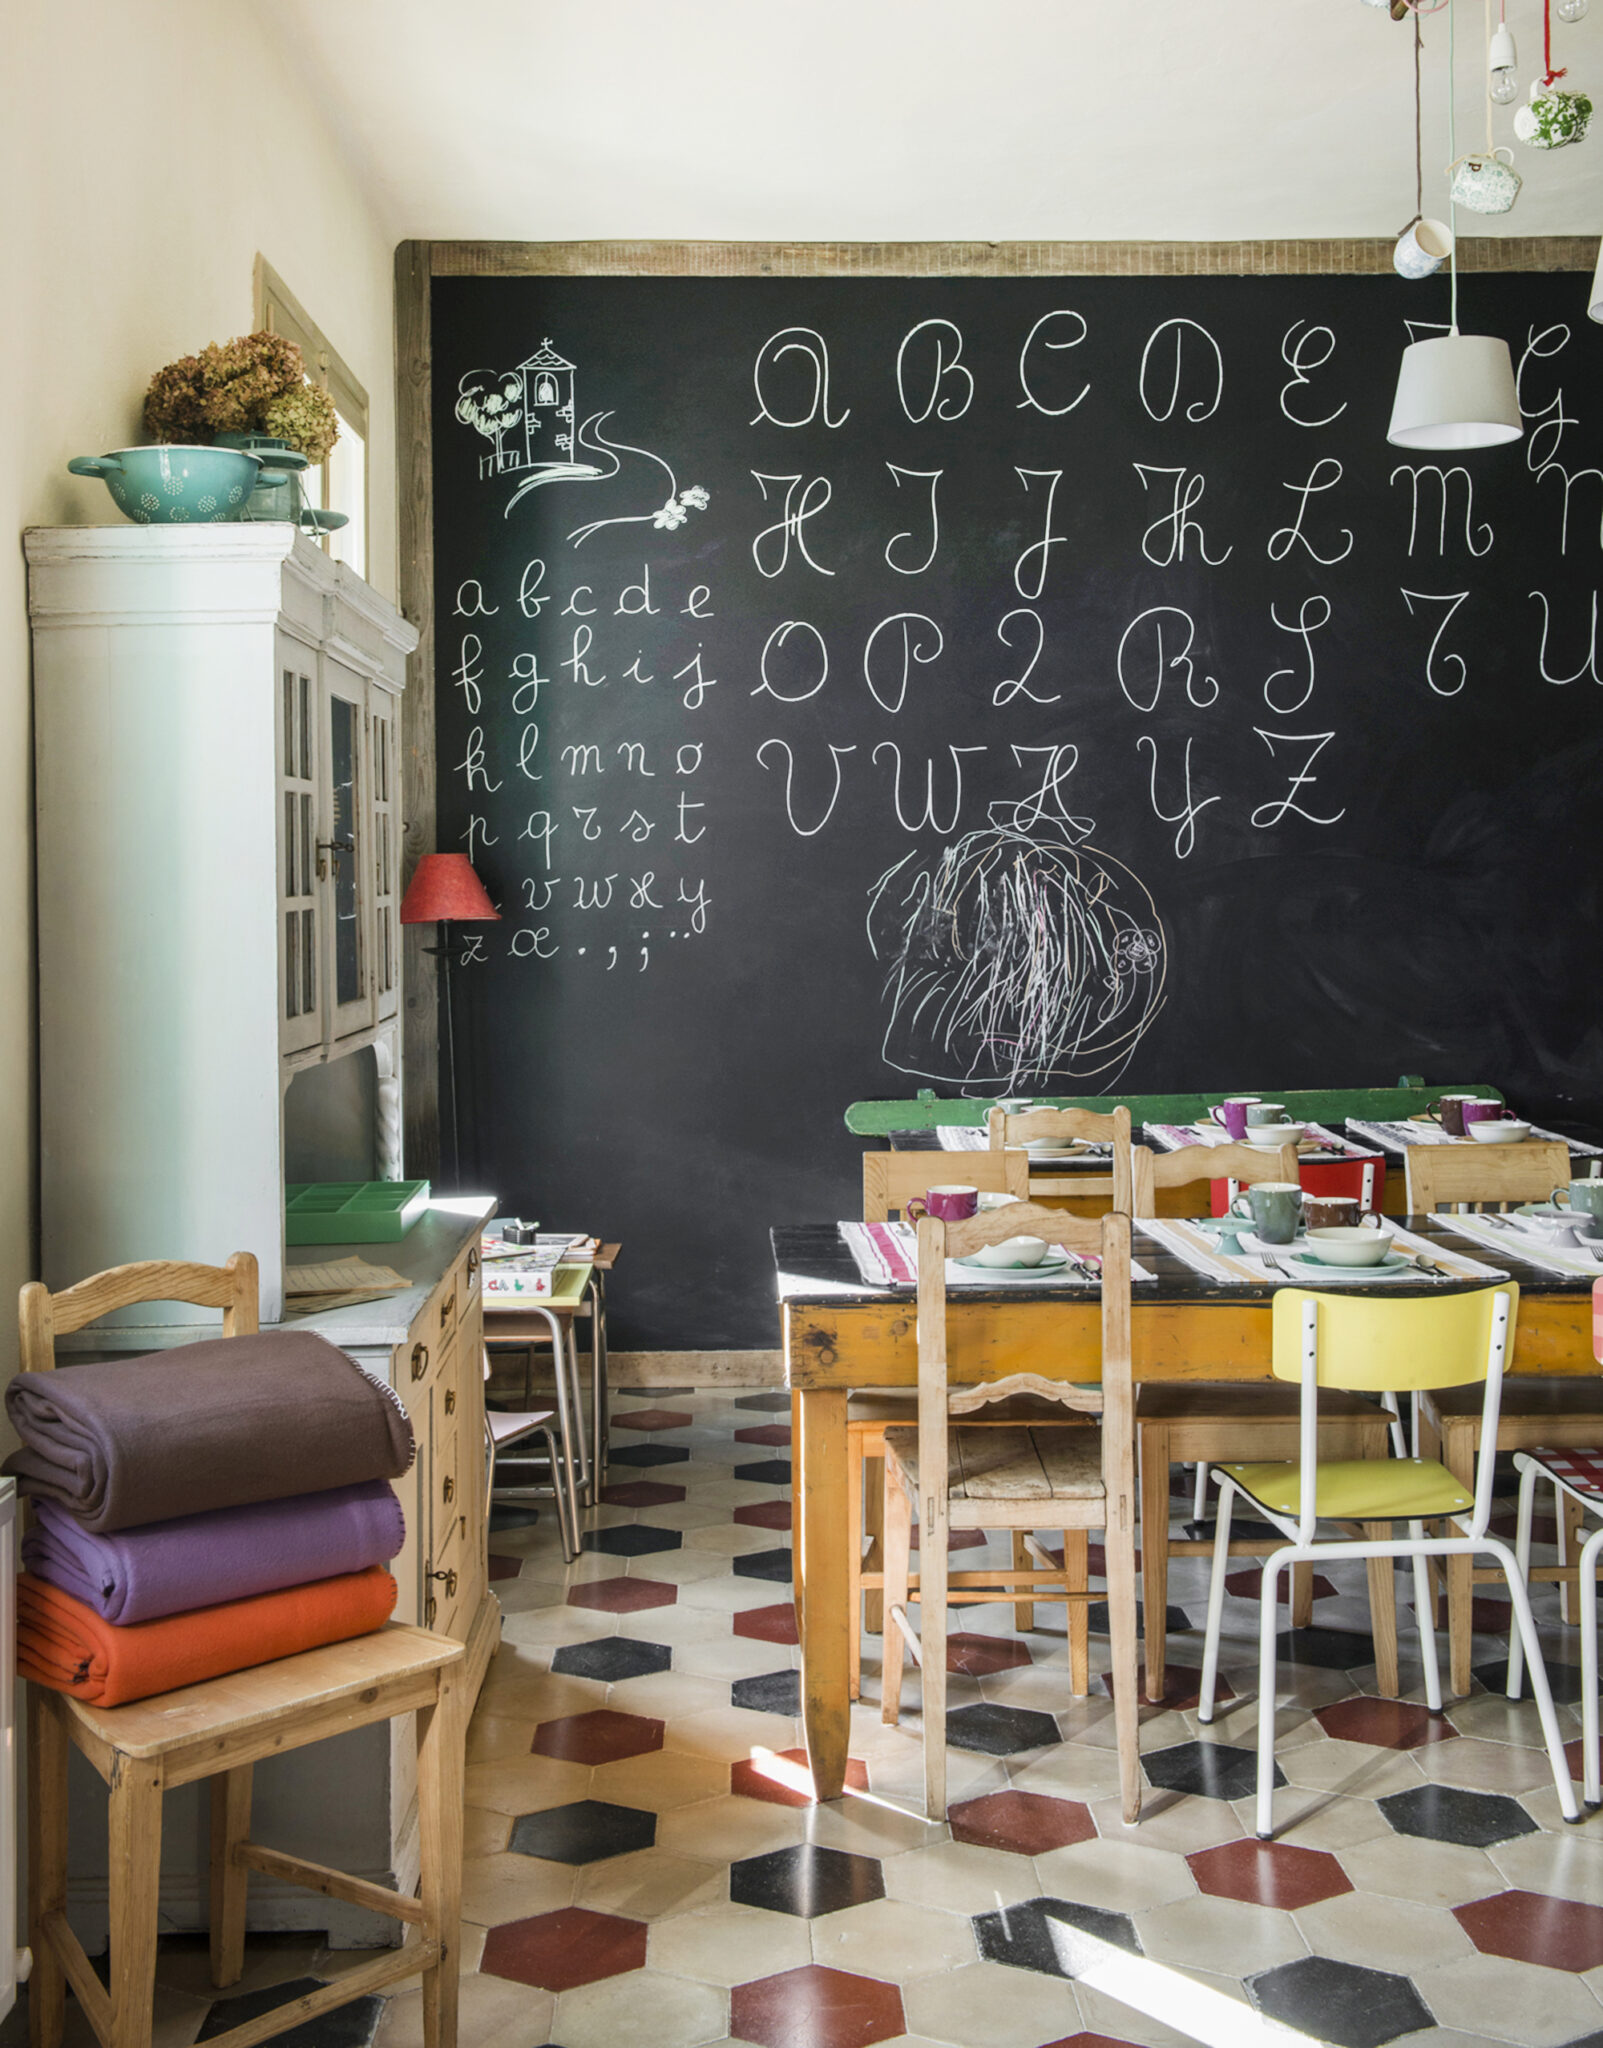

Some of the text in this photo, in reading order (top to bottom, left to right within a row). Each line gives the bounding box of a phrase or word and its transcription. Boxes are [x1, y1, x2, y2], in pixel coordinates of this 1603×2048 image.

[897, 319, 975, 424] B
[1015, 310, 1091, 416] C
[1139, 318, 1224, 422] D
[1280, 319, 1348, 428] E
[1267, 457, 1354, 565] L
[451, 558, 715, 618] a b c d e
[451, 624, 718, 715] f g h i j
[749, 620, 829, 703] O
[864, 612, 944, 714] P
[1117, 606, 1220, 713] R
[453, 722, 704, 793] k l m n o
[1136, 735, 1222, 860] Y
[1250, 726, 1346, 829] Z
[517, 810, 560, 870] q
[619, 809, 656, 843] s
[674, 790, 706, 844] t
[521, 877, 561, 911] v
[572, 873, 619, 910] w
[676, 877, 713, 934] y
[460, 935, 489, 967] z
